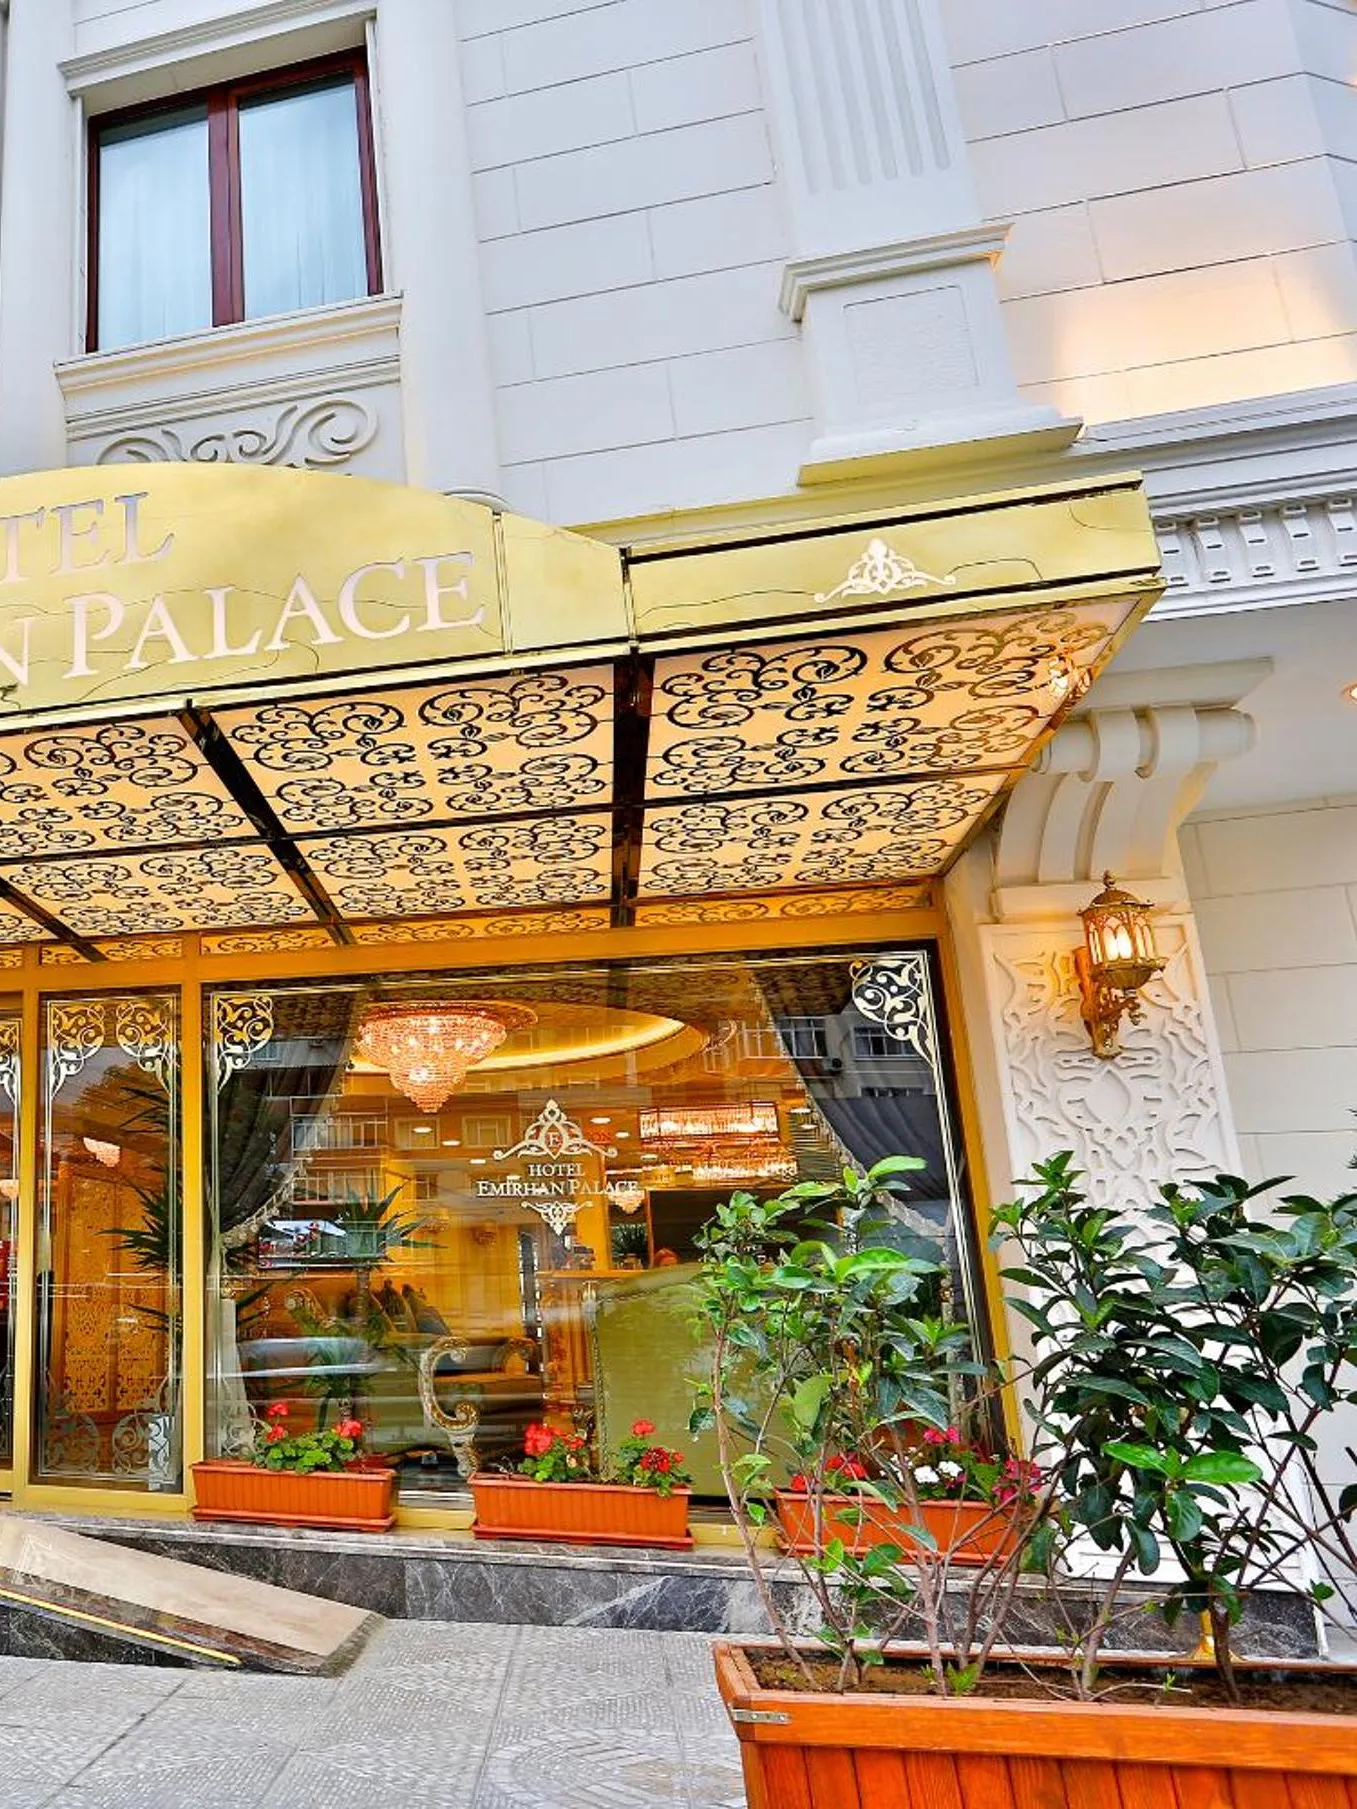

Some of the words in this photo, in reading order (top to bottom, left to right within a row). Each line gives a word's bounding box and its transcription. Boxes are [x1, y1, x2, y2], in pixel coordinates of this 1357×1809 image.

[62, 551, 486, 679] PALACE
[528, 1162, 586, 1177] HOTEL
[567, 1178, 639, 1196] PALACE
